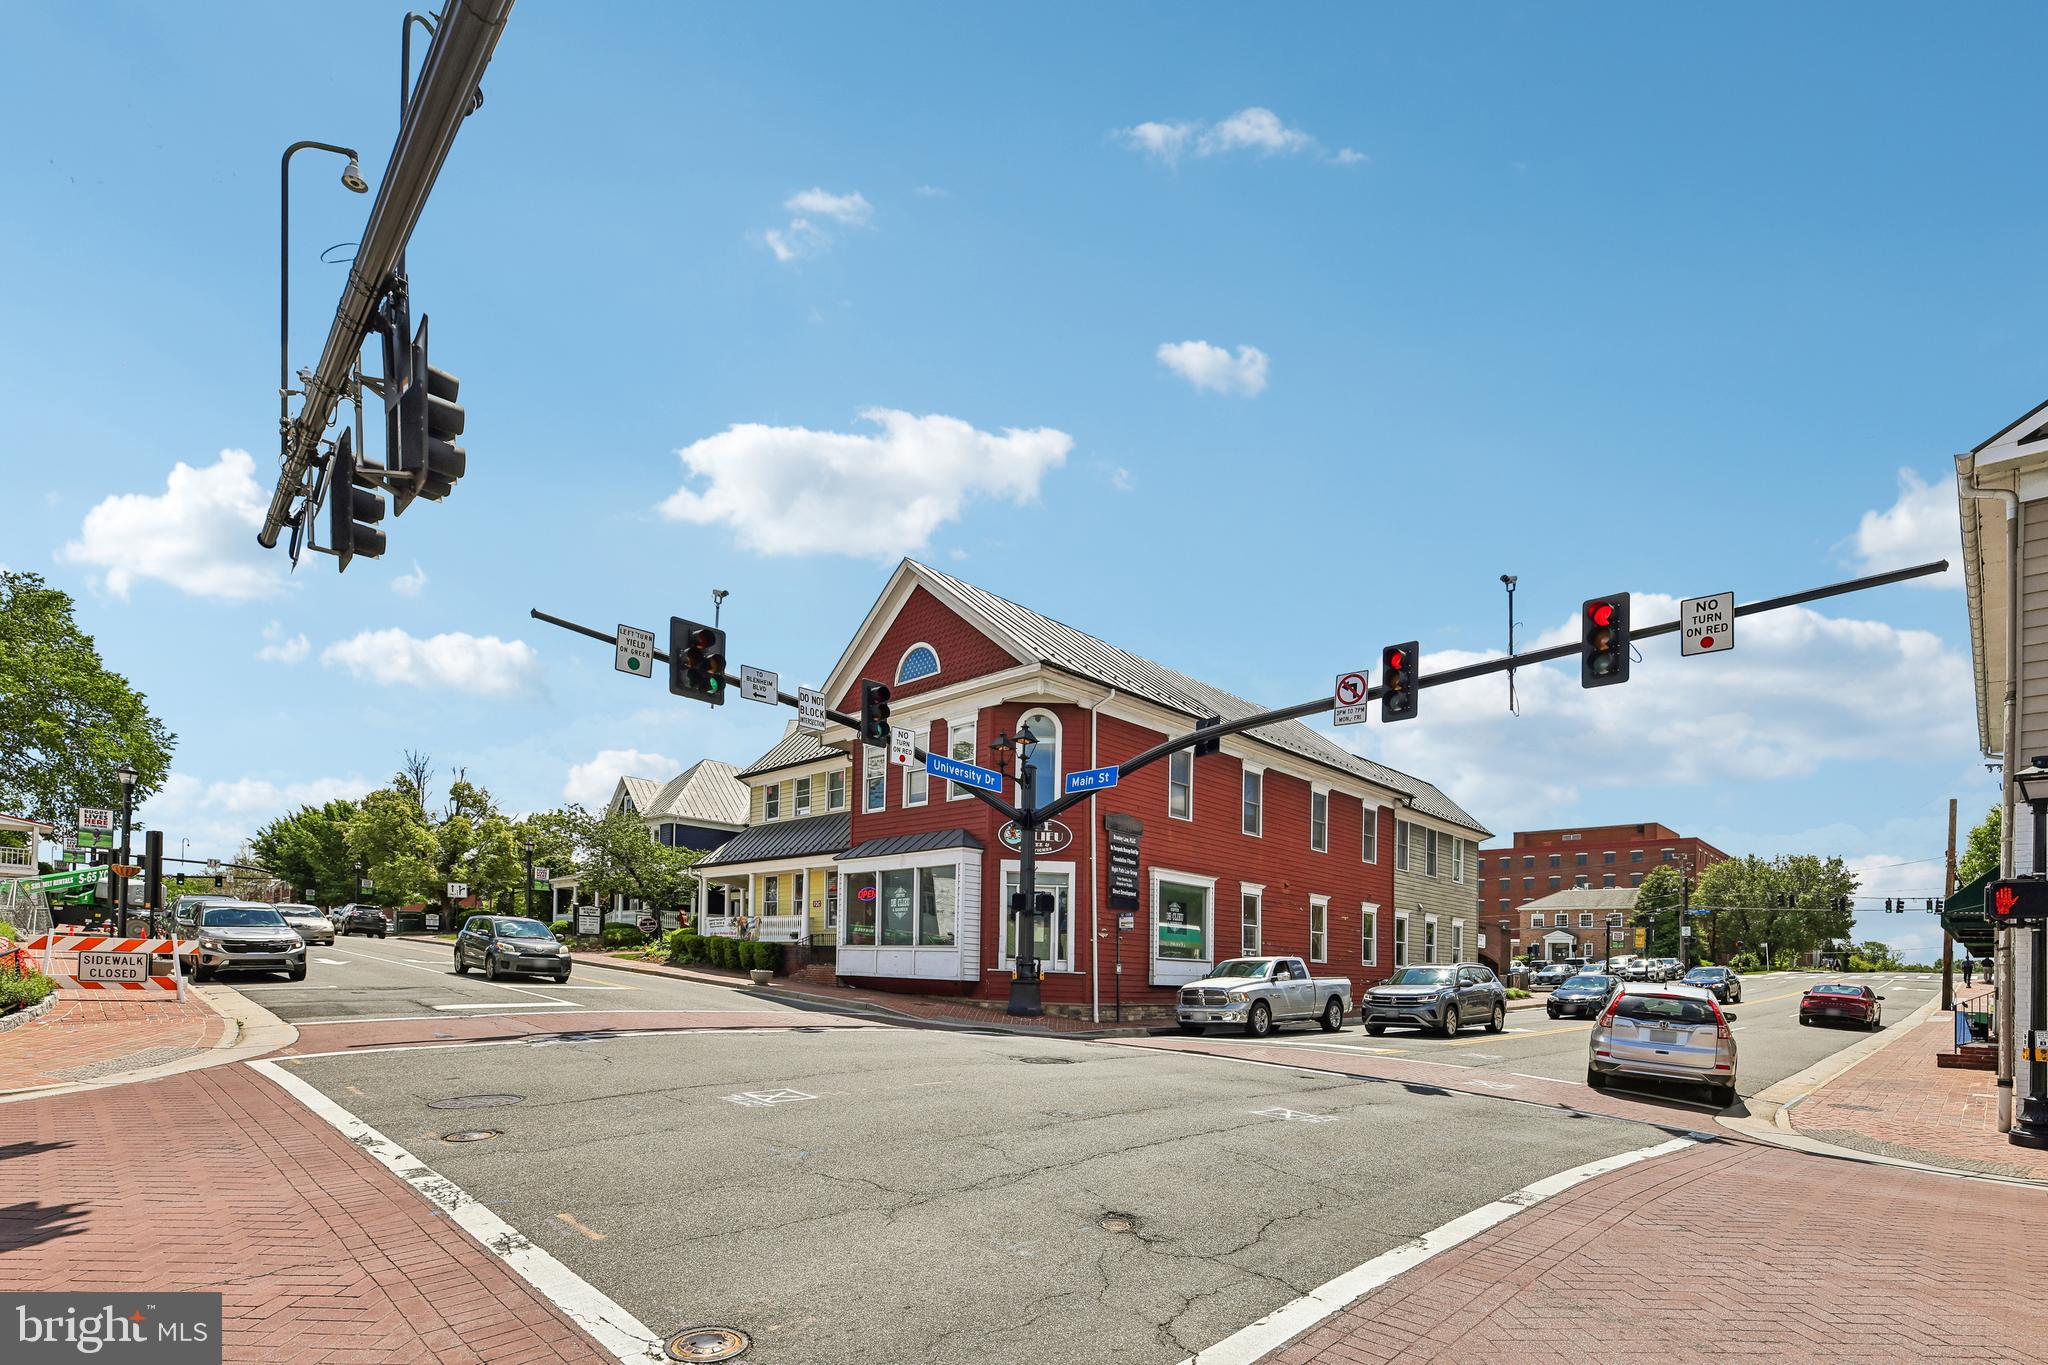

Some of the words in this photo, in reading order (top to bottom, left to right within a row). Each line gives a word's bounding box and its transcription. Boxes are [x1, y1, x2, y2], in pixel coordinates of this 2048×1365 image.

[1696, 599, 1718, 613] NO
[1692, 612, 1722, 625] TURN
[1686, 627, 1701, 637] ON
[1706, 623, 1728, 634] RED
[636, 631, 652, 641] TURN
[626, 638, 646, 649] YIELD
[631, 649, 650, 658] GREEN
[746, 675, 773, 686] BLENHEIM
[752, 684, 767, 692] BLVD
[800, 692, 809, 703] DO
[811, 695, 824, 706] NOT
[800, 705, 825, 719] BLOCK
[898, 731, 909, 739] NO
[896, 739, 910, 747] TURN
[933, 759, 982, 784] University
[985, 773, 996, 785] Dr
[1071, 775, 1094, 787] Main
[1098, 772, 1110, 783] St
[1034, 831, 1064, 842] LIEU
[78, 871, 97, 884] S-65
[83, 955, 143, 966] SIDEWALK
[89, 968, 137, 978] CLOSED
